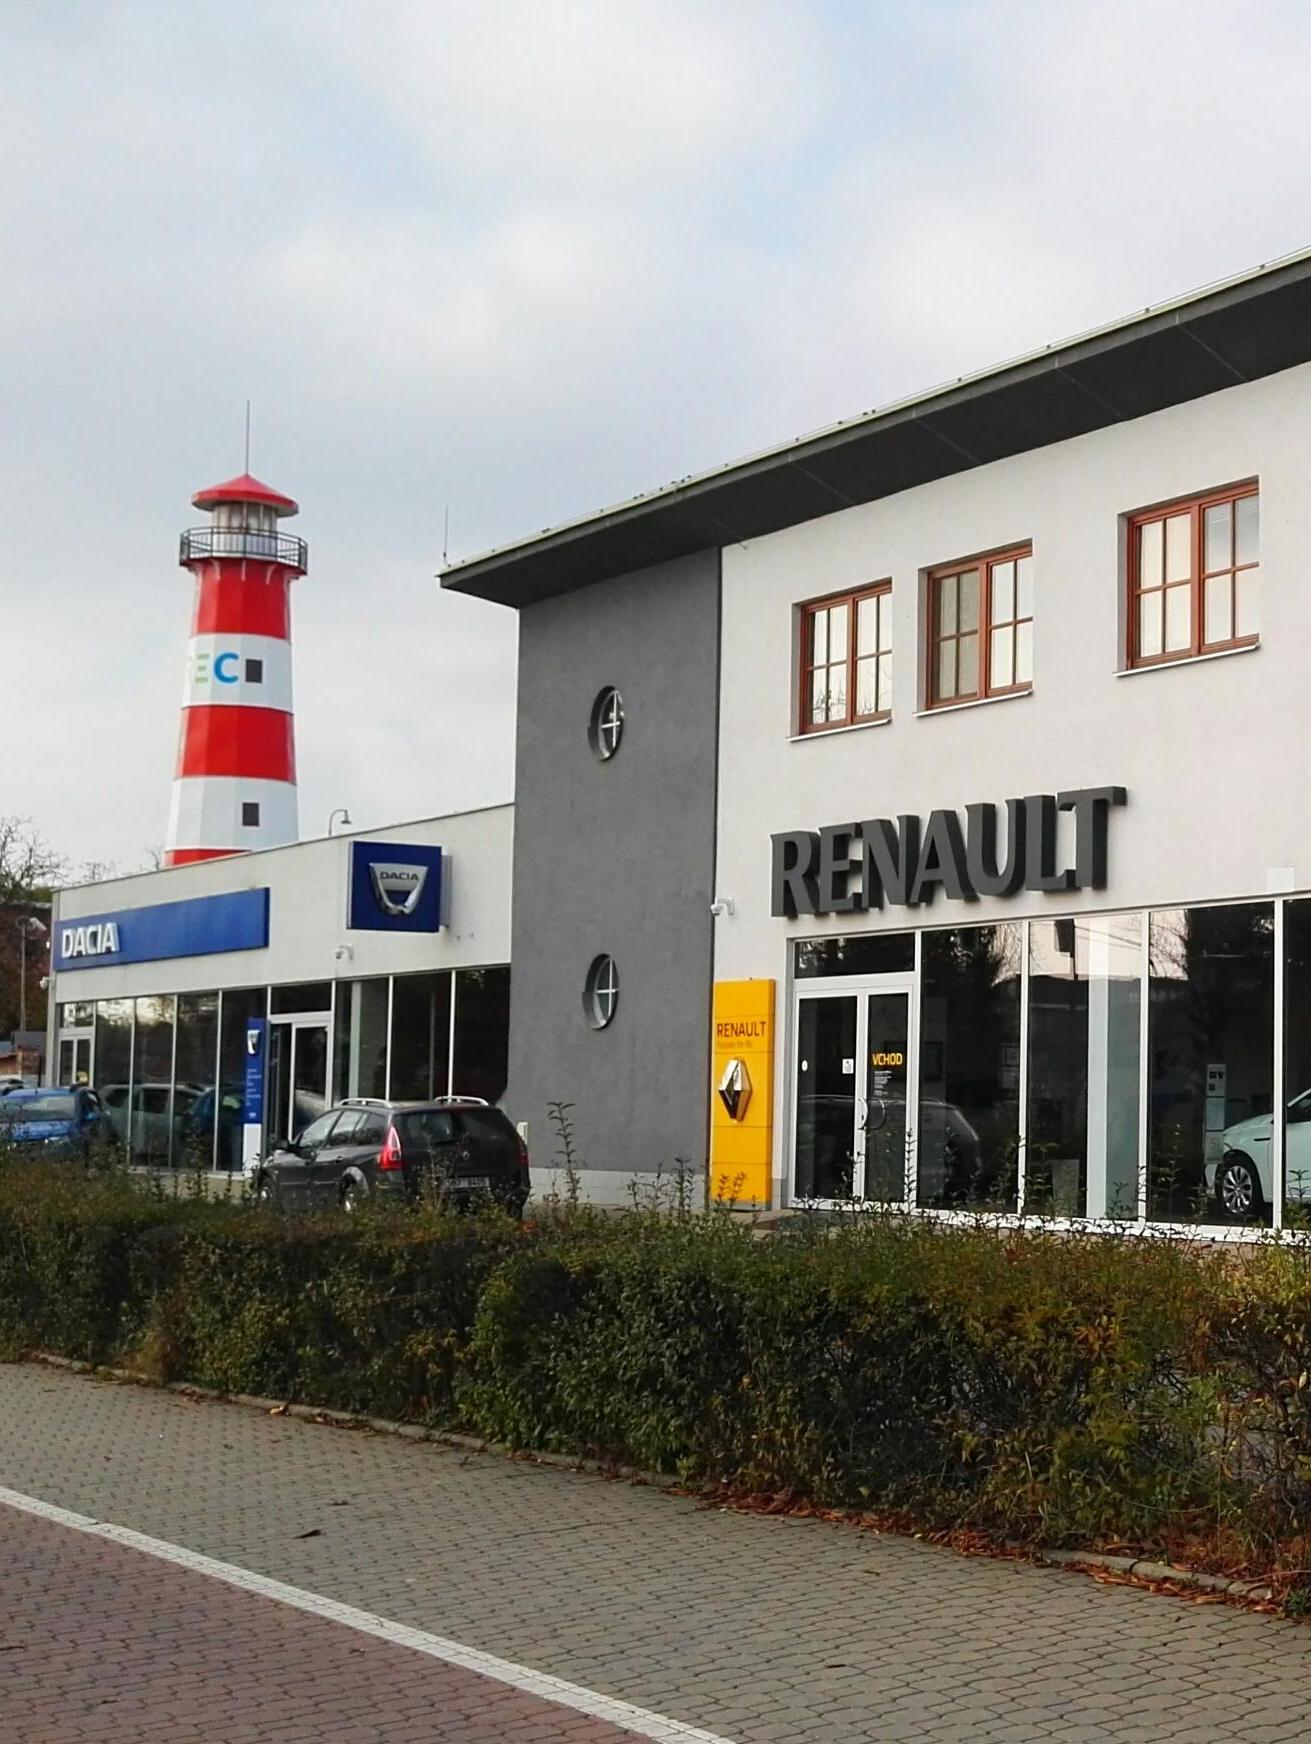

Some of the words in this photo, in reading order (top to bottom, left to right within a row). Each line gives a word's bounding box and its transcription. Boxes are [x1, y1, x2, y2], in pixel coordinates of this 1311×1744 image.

[770, 786, 1127, 918] RENAULT
[380, 871, 420, 880] DACIA
[62, 922, 120, 959] DACIA
[716, 1021, 767, 1038] RENAULT
[872, 1053, 903, 1066] VCHOD
